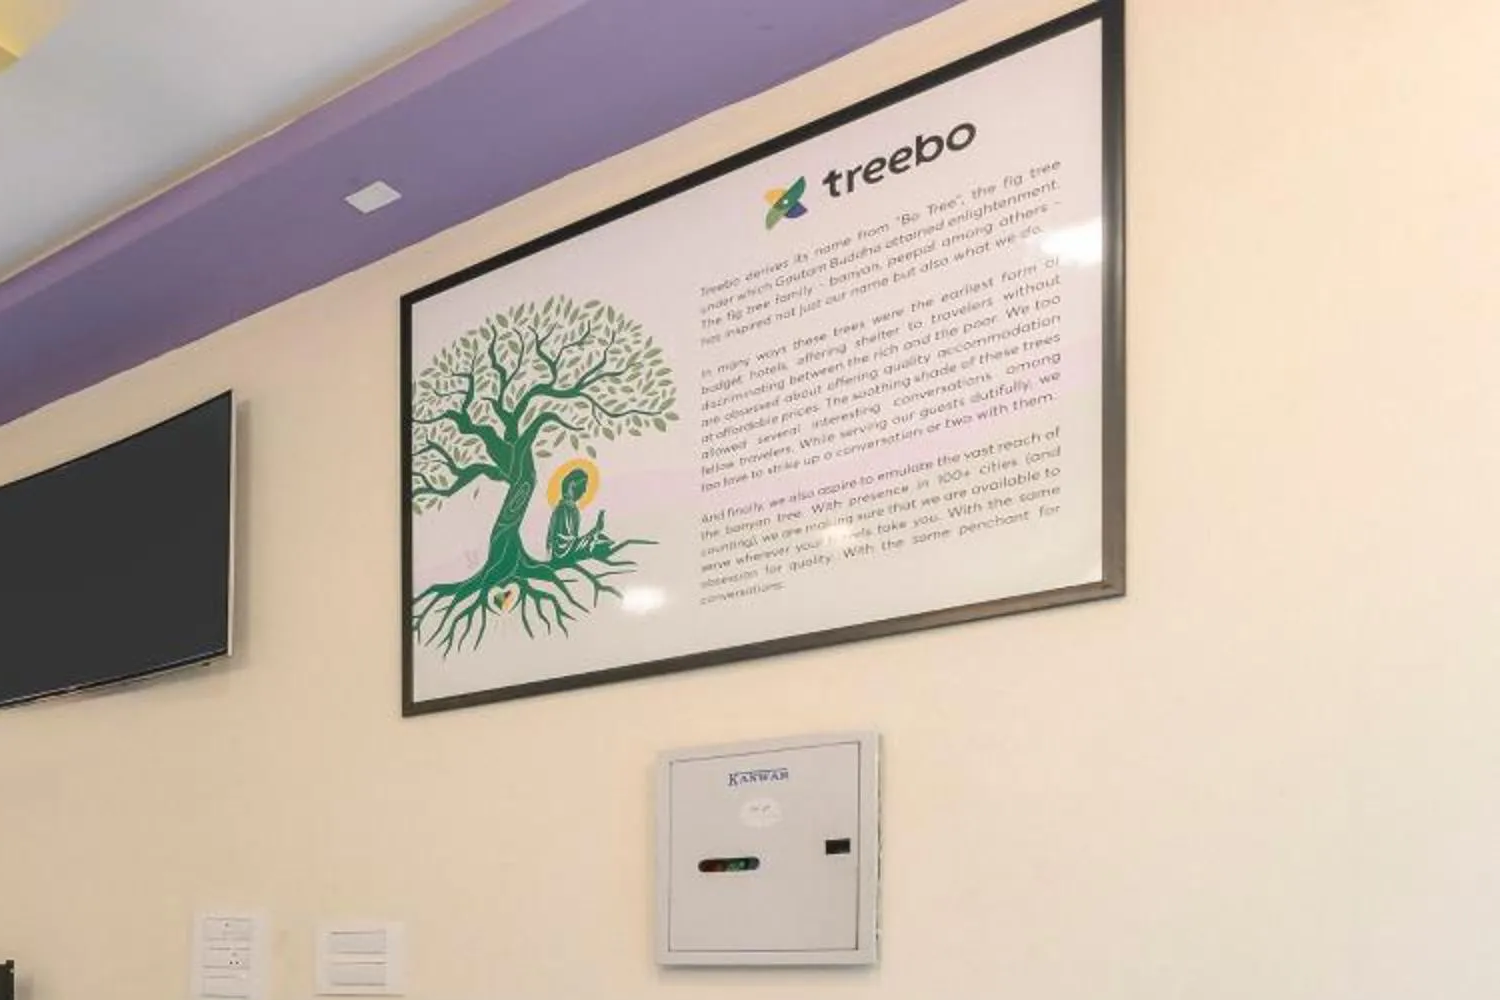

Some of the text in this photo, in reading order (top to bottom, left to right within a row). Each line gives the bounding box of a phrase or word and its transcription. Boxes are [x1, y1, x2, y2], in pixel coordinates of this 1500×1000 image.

[822, 122, 977, 198] treebo
[744, 258, 788, 282] derives
[814, 236, 851, 257] name
[857, 222, 889, 242] from
[971, 183, 996, 201] the
[1003, 173, 1023, 190] fig
[1029, 160, 1061, 180] tree
[775, 262, 826, 288] Gautam
[829, 243, 881, 269] Buddha
[885, 218, 944, 250] attained
[887, 238, 935, 270] peepal
[941, 221, 993, 247] among
[999, 203, 1048, 228] others
[756, 343, 787, 361] ways
[793, 331, 826, 349] these
[832, 319, 864, 337] trees
[872, 306, 904, 325] were
[911, 297, 933, 312] the
[941, 275, 993, 303] earliest
[1001, 264, 1036, 284] form
[825, 290, 846, 305] our
[850, 276, 888, 297] name
[893, 263, 916, 282] but
[920, 255, 949, 273] also
[953, 238, 990, 262] what
[995, 232, 1015, 247] we
[701, 373, 741, 395] budget
[796, 343, 846, 366] offering
[855, 325, 899, 348] shelter
[907, 318, 923, 331] to
[931, 296, 993, 324] travelers
[1003, 273, 1060, 301] without
[701, 378, 785, 411] discriminating
[789, 361, 843, 385] between
[847, 353, 869, 367] the
[874, 340, 899, 359] rich
[903, 330, 930, 350] and
[934, 325, 958, 340] the
[1005, 303, 1029, 319] We
[1035, 294, 1061, 310] too
[784, 382, 821, 403] about
[826, 367, 878, 391] offering
[883, 352, 930, 378] quality
[937, 313, 1061, 358] accommodation
[825, 393, 849, 408] The
[852, 375, 911, 400] soothing
[913, 362, 956, 383] shade
[961, 354, 975, 369] of
[979, 344, 1019, 364] these
[1023, 332, 1061, 351] trees
[701, 352, 1061, 460] allowed several interesting conversations among
[701, 459, 734, 476] fellow
[799, 431, 835, 449] While
[839, 418, 887, 438] serving
[891, 410, 914, 425] our
[919, 396, 964, 421] guests
[1039, 370, 1061, 384] we
[701, 479, 720, 492] too
[723, 472, 748, 486] love
[751, 468, 762, 479] to
[803, 453, 819, 467] up
[835, 426, 923, 457] conversation
[926, 421, 940, 433] or
[945, 413, 972, 428] two
[976, 401, 1008, 420] with
[700, 527, 719, 540] the
[725, 516, 770, 534] banyan
[811, 496, 842, 514] With
[849, 483, 908, 509] presence
[917, 477, 929, 489] in
[979, 457, 1017, 475] cities
[1025, 444, 1061, 468] (and
[701, 508, 724, 524] And
[769, 496, 785, 507] we
[789, 489, 814, 503] also
[817, 479, 856, 496] aspire
[860, 474, 873, 486] to
[877, 459, 933, 482] emulate
[937, 452, 960, 467] the
[963, 442, 995, 461] vast
[997, 431, 1040, 453] reach
[1044, 426, 1060, 441] of
[761, 531, 778, 542] we
[781, 525, 802, 538] are
[857, 506, 884, 521] sure
[887, 496, 916, 514] that
[921, 493, 940, 506] we
[943, 487, 967, 501] are
[971, 470, 1040, 495] available
[1044, 465, 1061, 478] to
[735, 544, 790, 564] wherever
[794, 537, 823, 555] you
[877, 518, 906, 533] take
[947, 499, 982, 518] With
[987, 495, 1012, 509] the
[1019, 484, 1060, 502] same
[764, 563, 781, 575] for
[843, 541, 874, 558] With
[881, 537, 904, 551] the
[912, 527, 950, 544] same
[959, 507, 1028, 538] penchant
[1039, 503, 1060, 516] for
